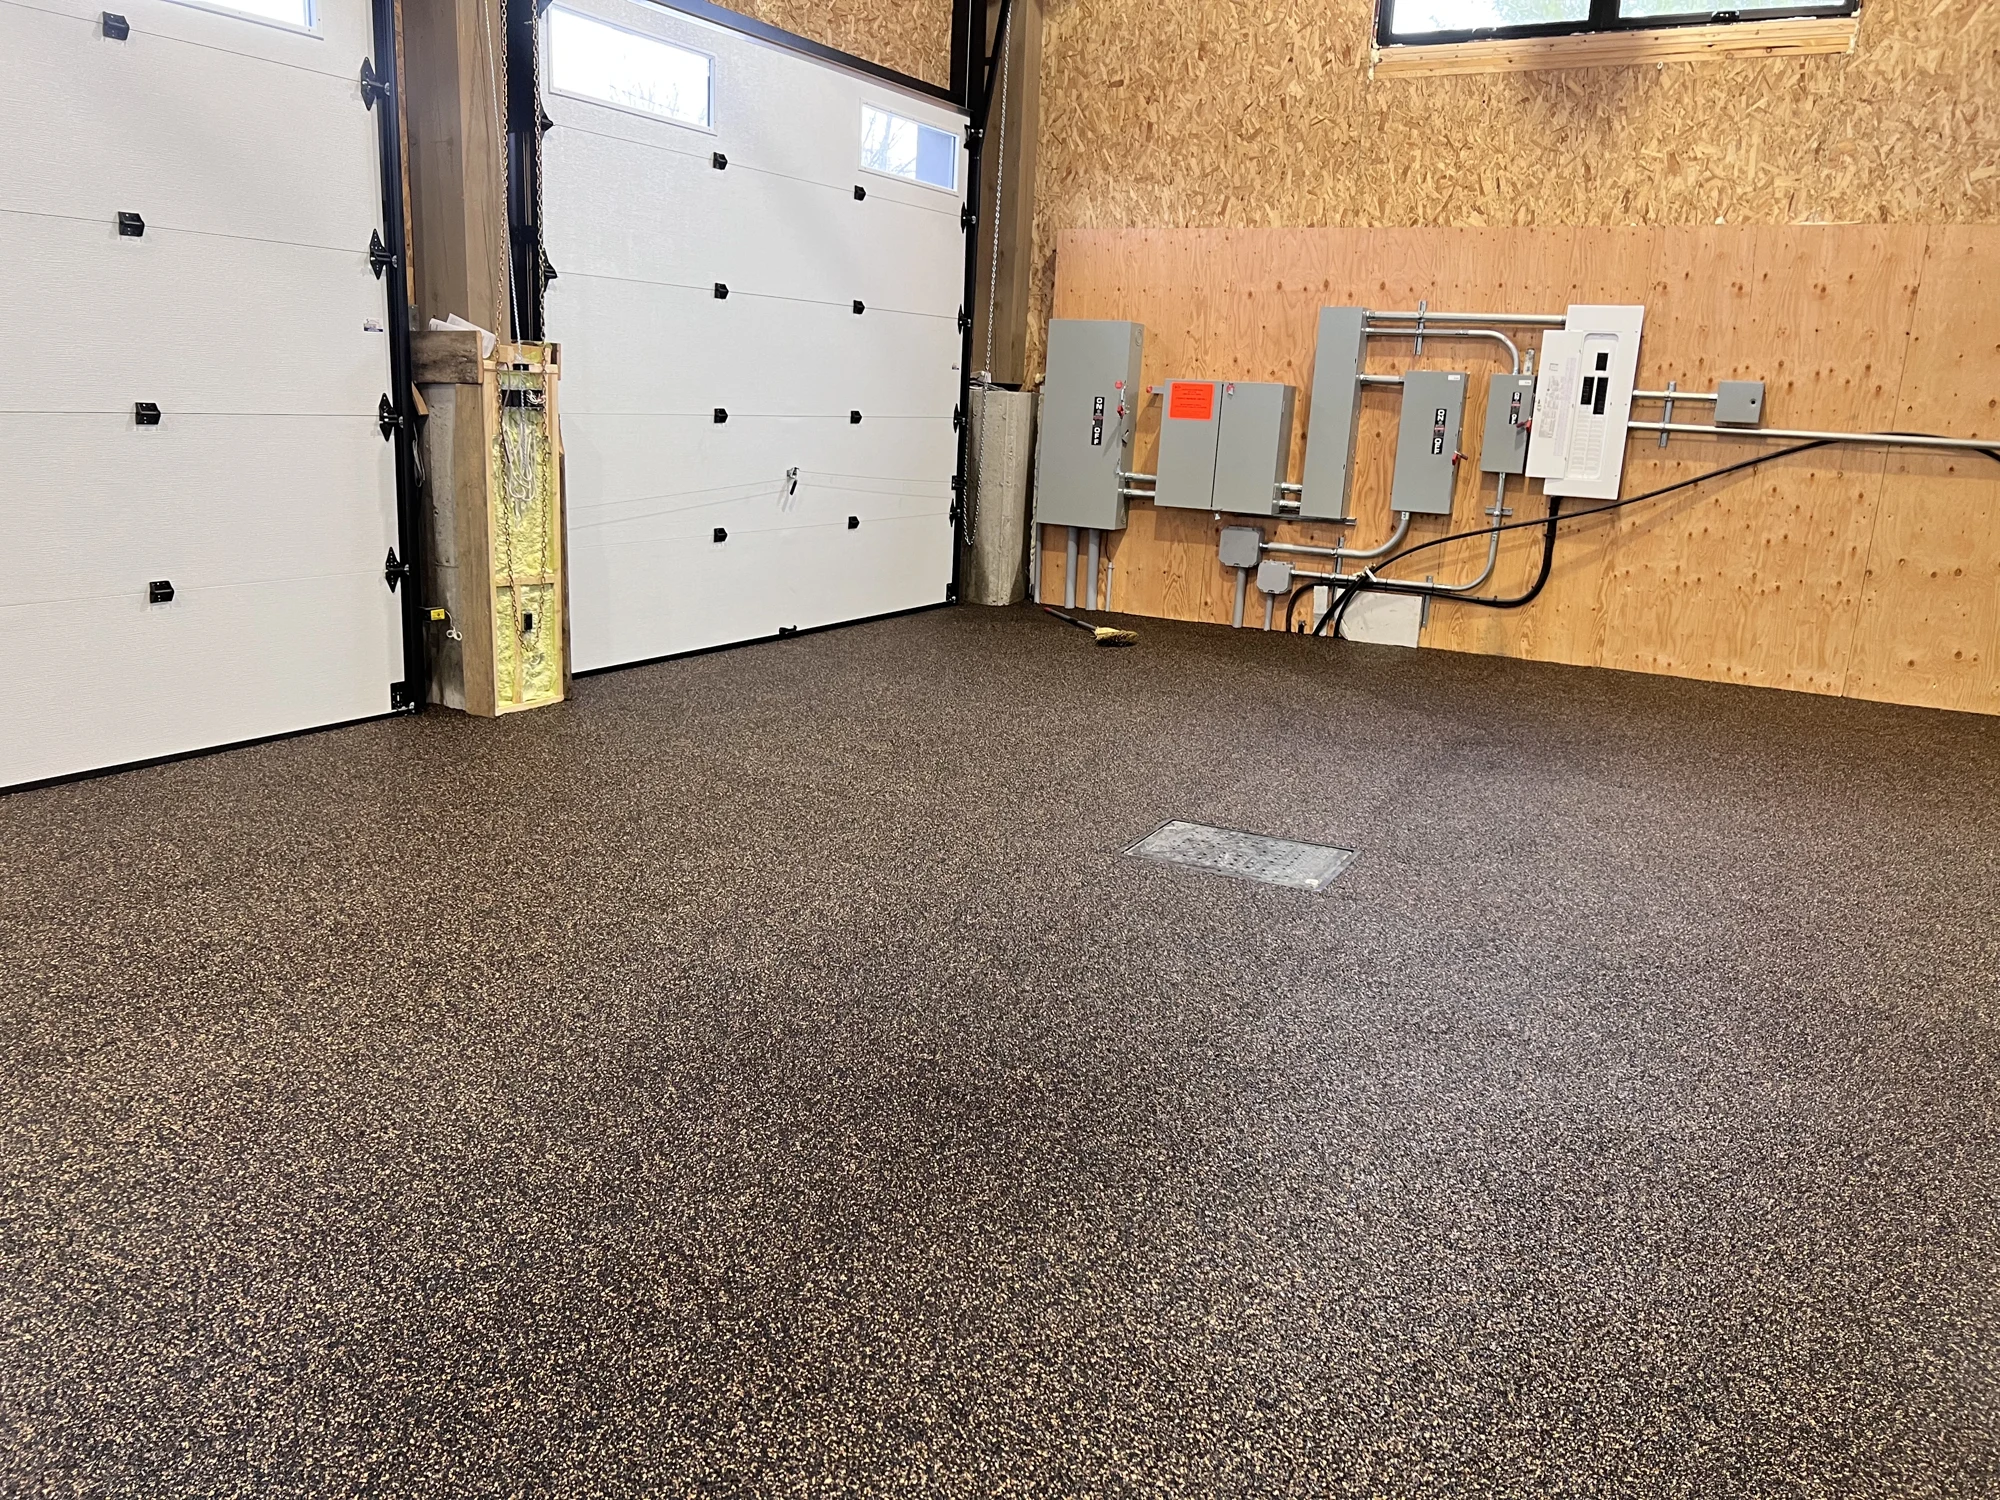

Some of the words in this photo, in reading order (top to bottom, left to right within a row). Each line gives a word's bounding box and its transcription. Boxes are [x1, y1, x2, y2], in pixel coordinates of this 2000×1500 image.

[1096, 398, 1103, 410] ON
[1437, 410, 1445, 421] ON
[1434, 438, 1442, 454] OFF
